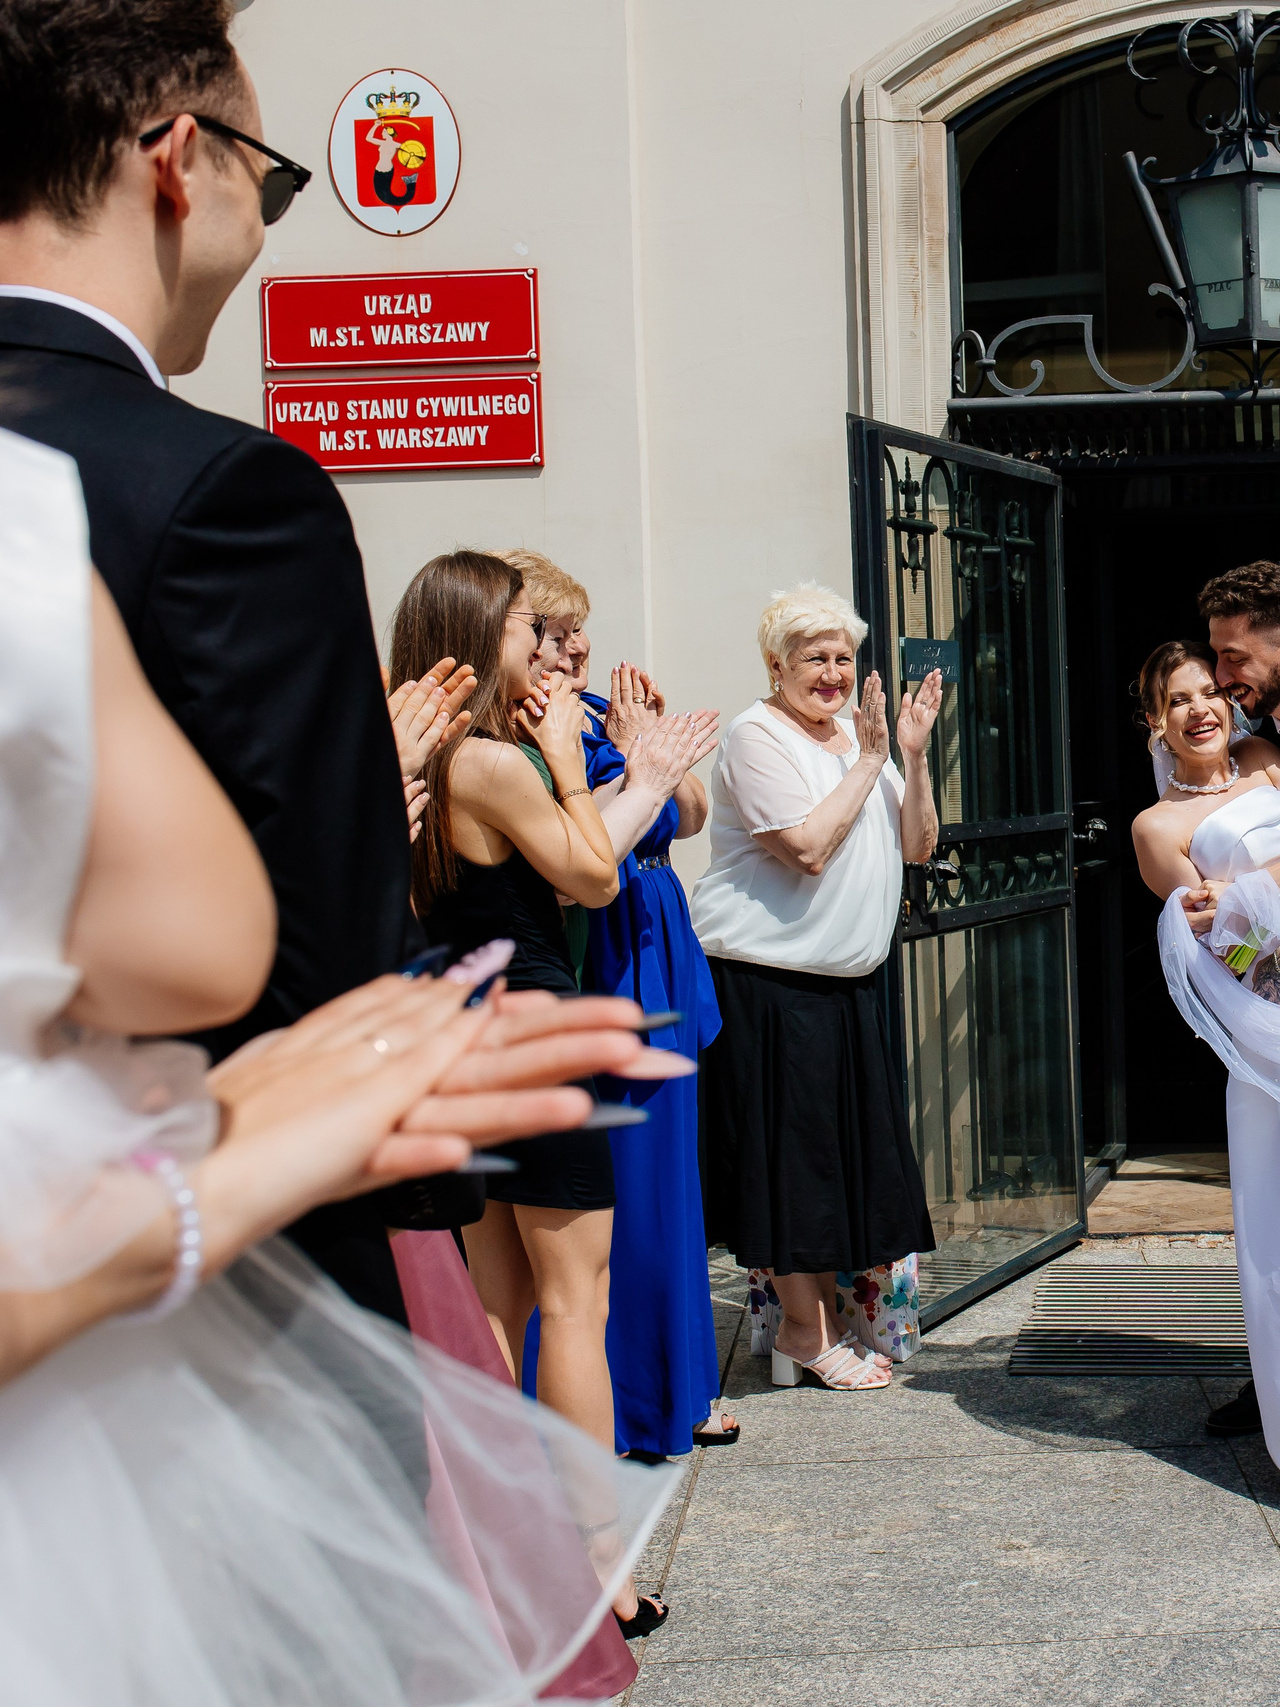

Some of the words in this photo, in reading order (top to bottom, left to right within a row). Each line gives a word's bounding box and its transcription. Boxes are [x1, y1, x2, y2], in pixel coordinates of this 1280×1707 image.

[1208, 281, 1231, 293] PLAC
[364, 293, 432, 318] URZĄD
[309, 326, 365, 347] M.ST.
[371, 321, 490, 345] WARSZAWY
[275, 401, 340, 425] URZĄD
[346, 398, 409, 421] STANU
[415, 393, 531, 418] CYWILNEGO
[319, 430, 371, 451] M.ST.
[376, 425, 490, 450] WARSZAWY
